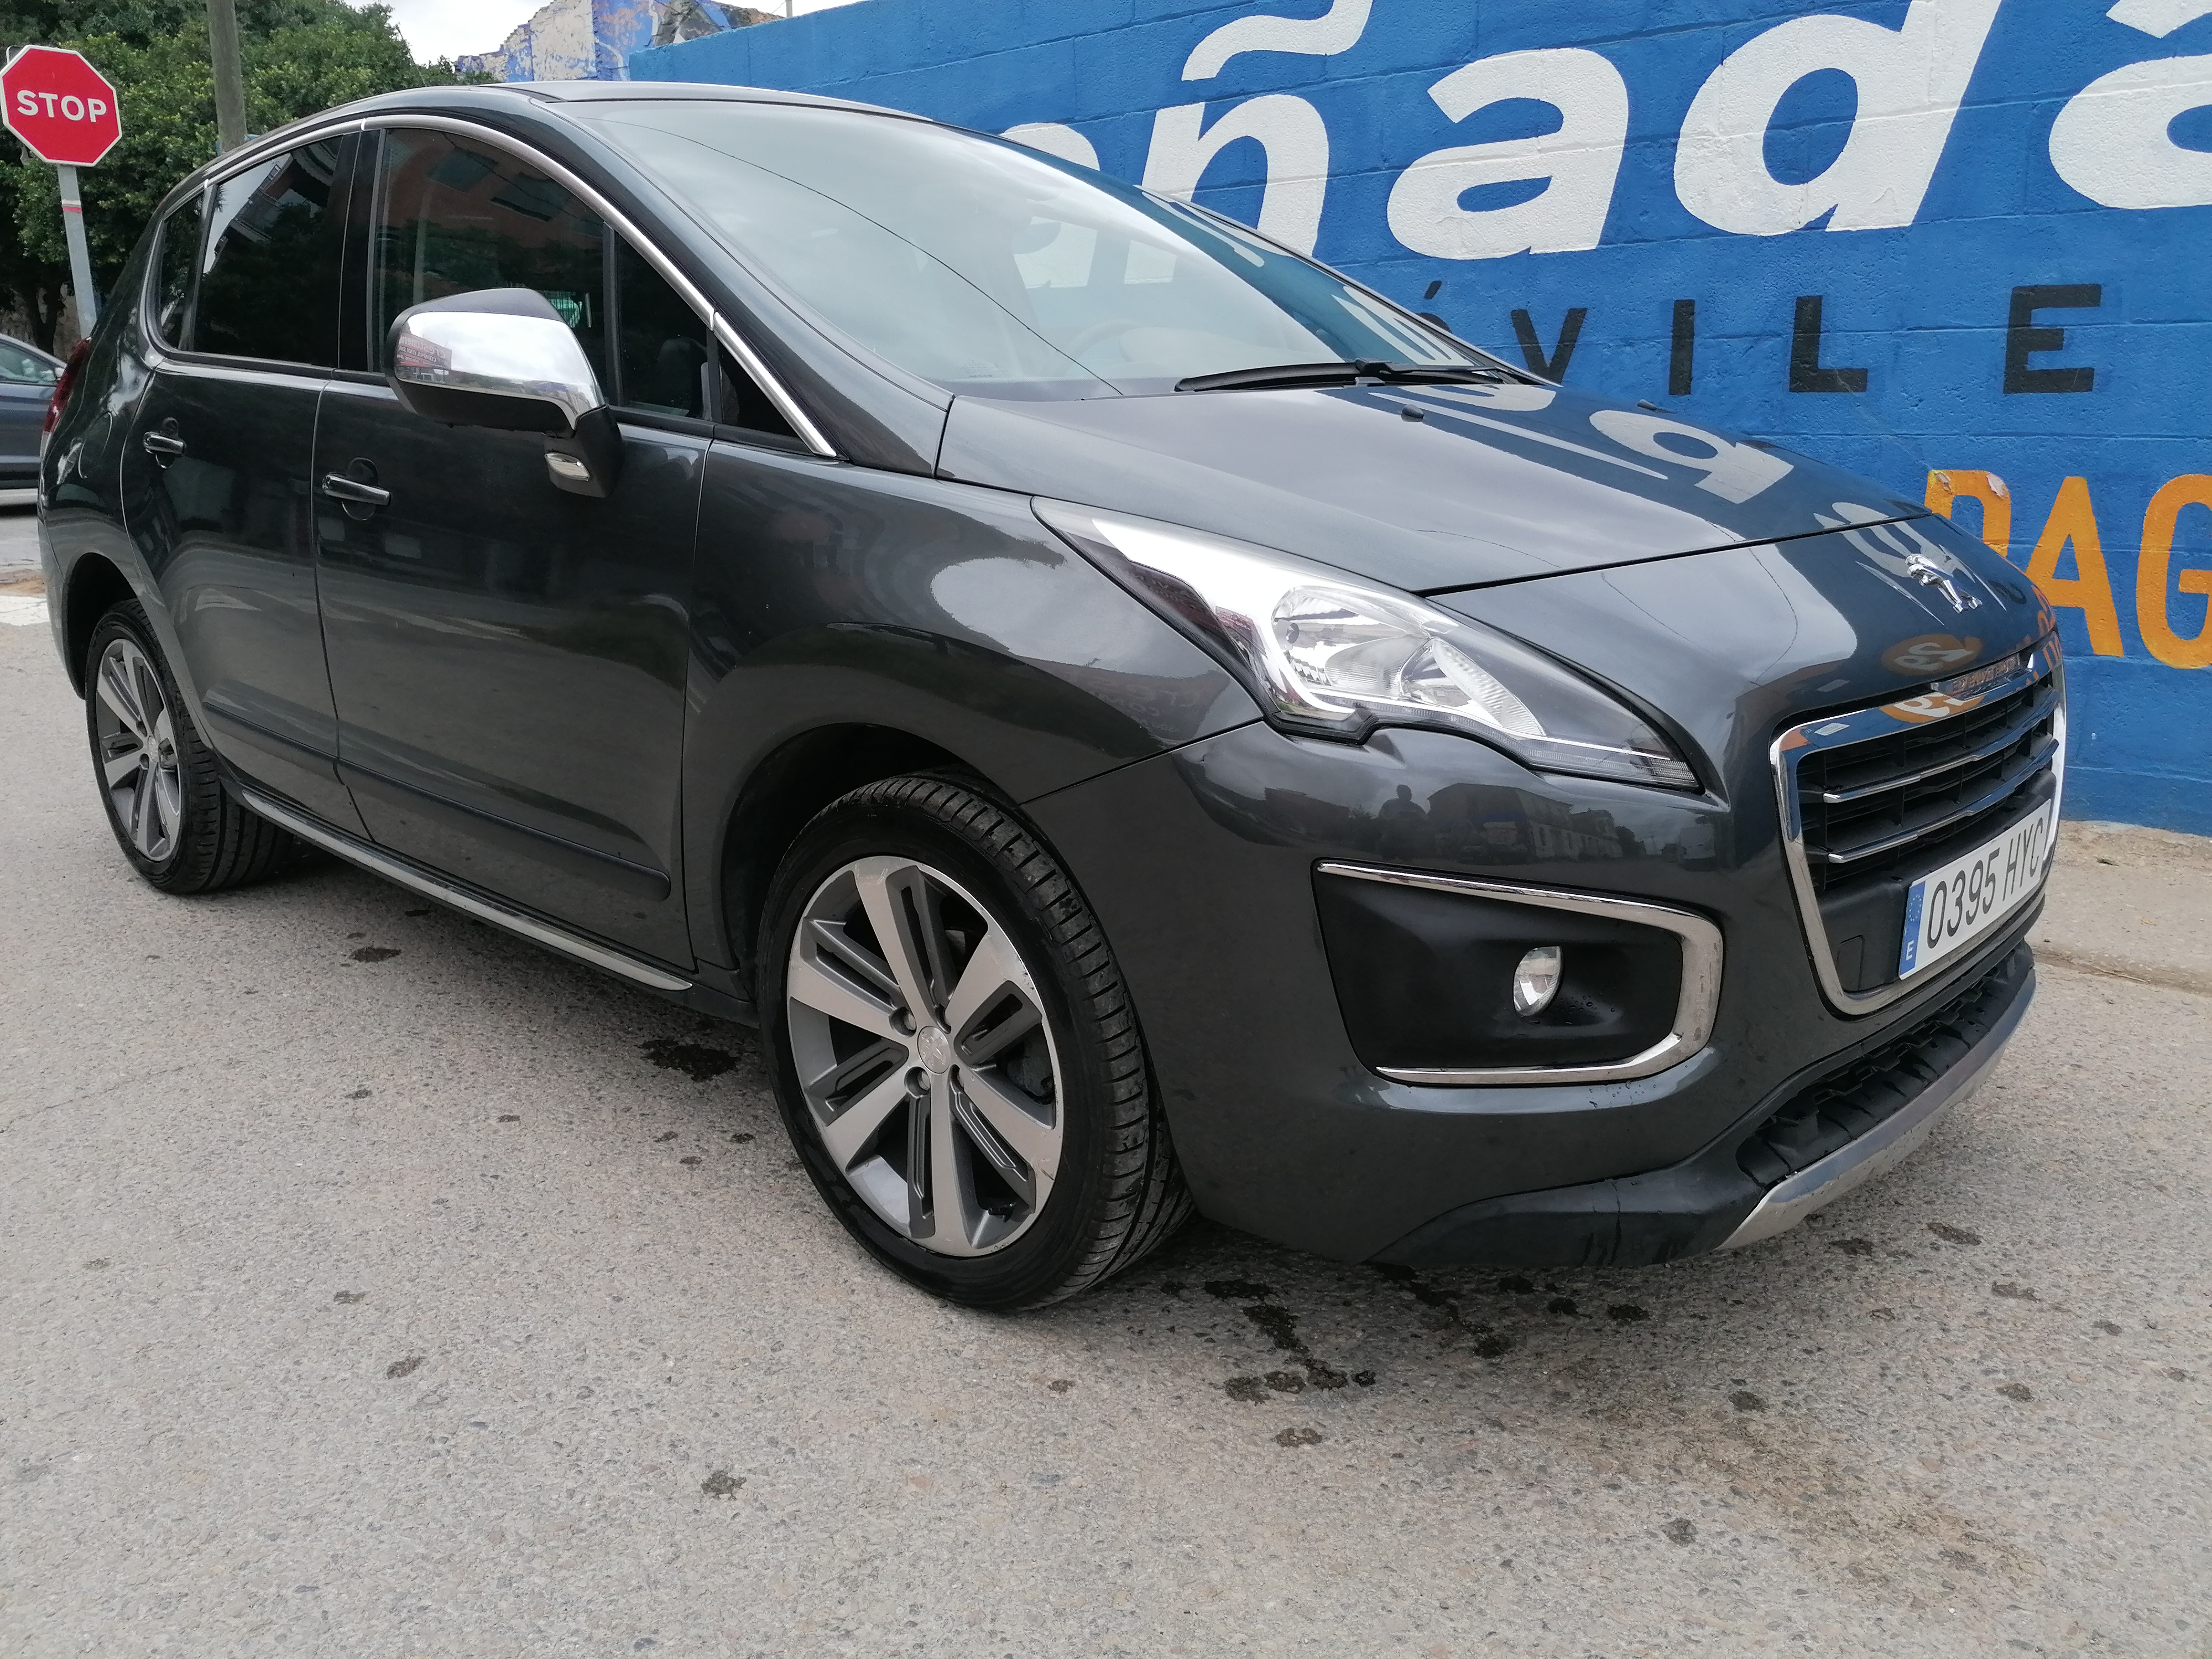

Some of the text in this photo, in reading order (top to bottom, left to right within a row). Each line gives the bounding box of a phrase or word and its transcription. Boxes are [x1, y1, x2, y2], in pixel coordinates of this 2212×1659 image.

[17, 90, 107, 123] STOP
[1927, 817, 2043, 949] 0395 HYC
[1906, 940, 1914, 961] E
